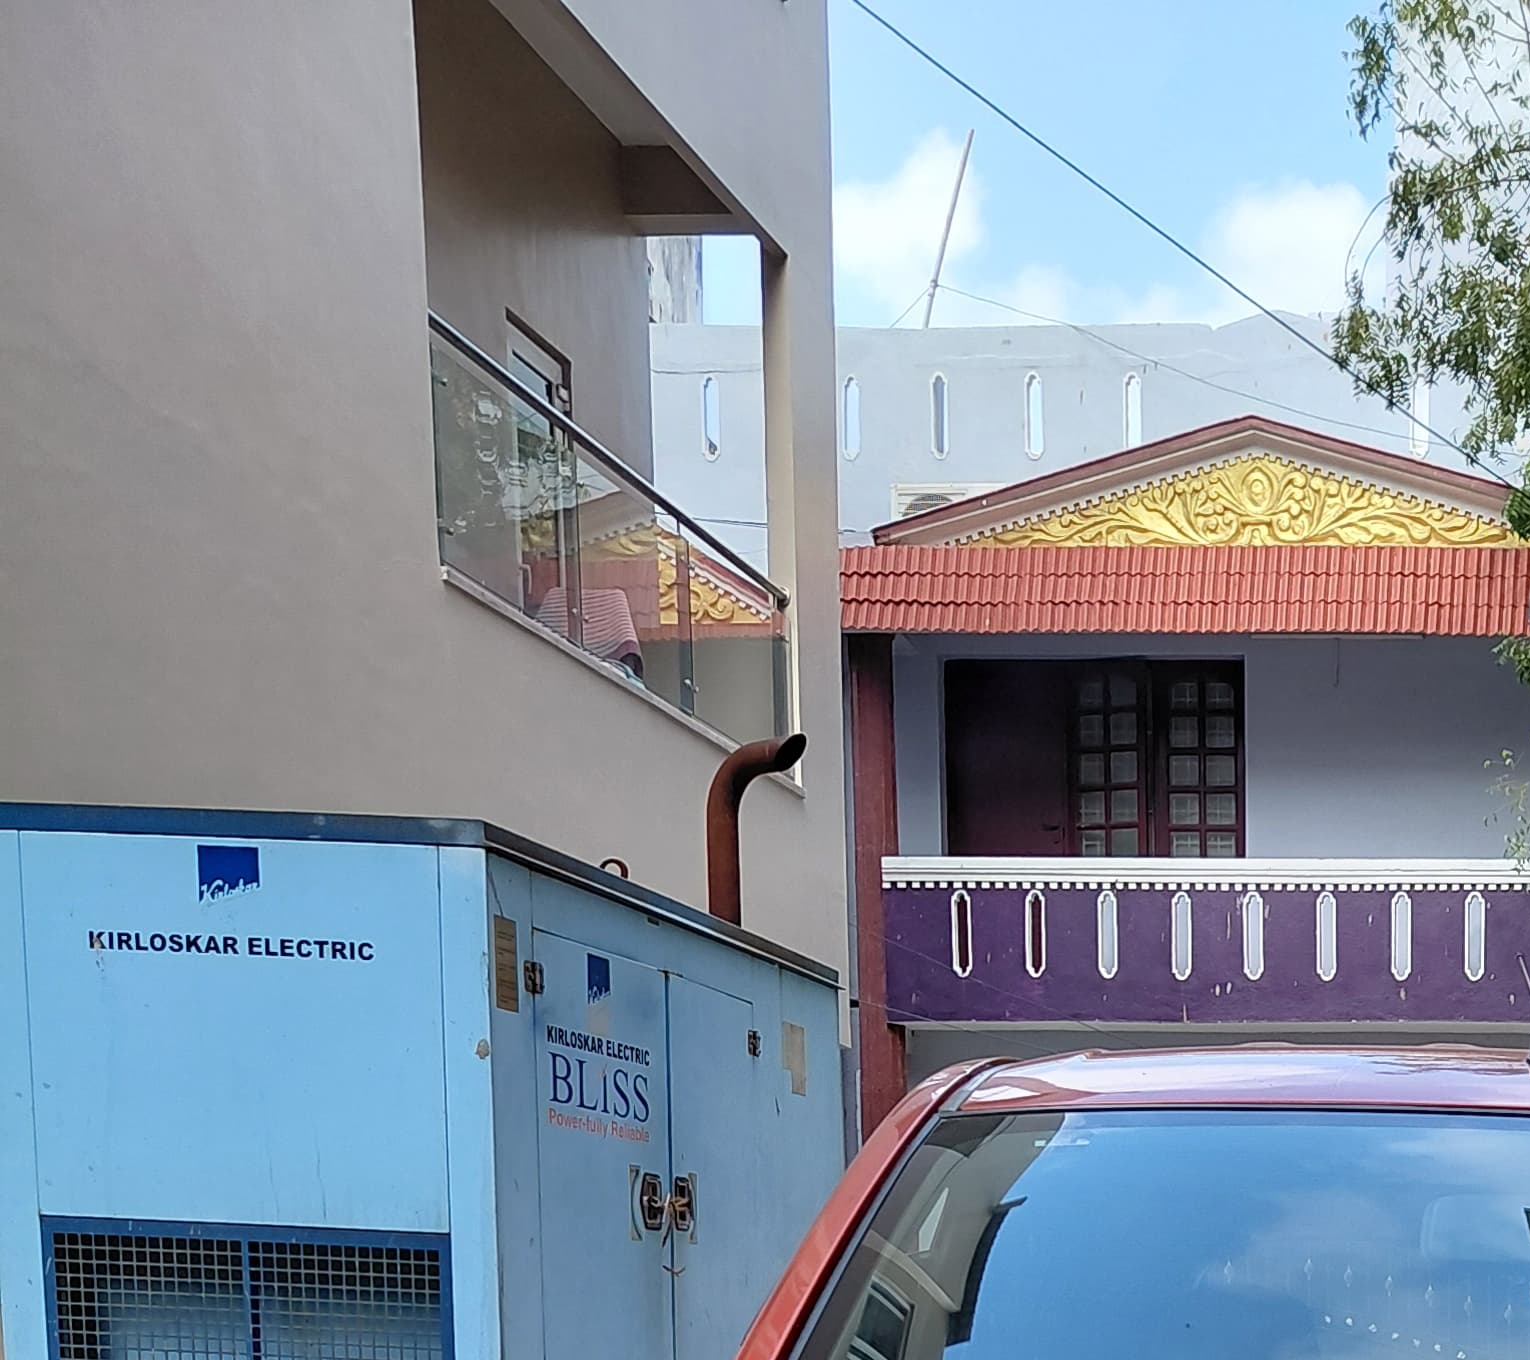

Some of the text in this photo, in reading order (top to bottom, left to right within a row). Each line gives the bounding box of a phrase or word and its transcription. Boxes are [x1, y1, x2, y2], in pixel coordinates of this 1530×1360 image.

[88, 930, 374, 961] KIRLOSKAR ELECTRIC
[546, 1024, 650, 1066] KIRLOSKAR ELECTRIC
